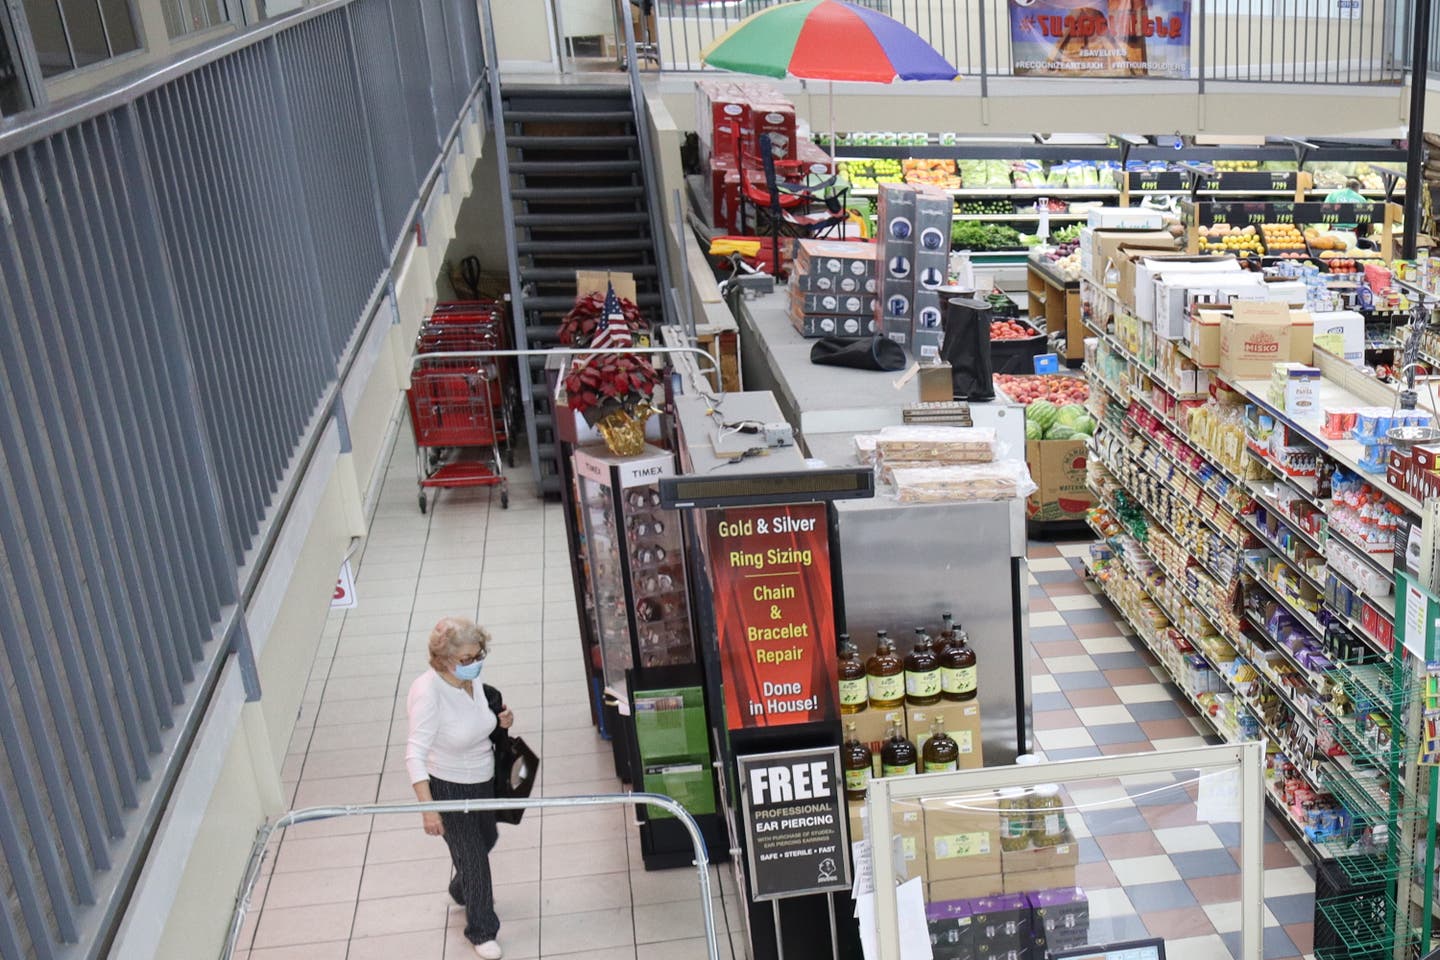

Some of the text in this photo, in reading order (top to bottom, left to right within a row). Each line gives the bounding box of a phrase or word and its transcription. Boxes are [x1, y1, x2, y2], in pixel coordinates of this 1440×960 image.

[1246, 343, 1278, 352] MISKO
[632, 466, 663, 478] TIMEX
[718, 516, 816, 538] Gold & Silver
[730, 548, 812, 569] Ring Sizing
[753, 585, 795, 601] Chain
[770, 605, 782, 620] &
[748, 623, 808, 641] Bracelet
[756, 646, 803, 665] Repair
[763, 681, 801, 697] Done
[749, 695, 818, 716] in House!
[750, 761, 830, 805] FREE
[754, 803, 832, 819] PROFESSIONAL
[756, 815, 834, 833] EAR PIERCING
[760, 845, 836, 861] SAFE STERILE FAST
